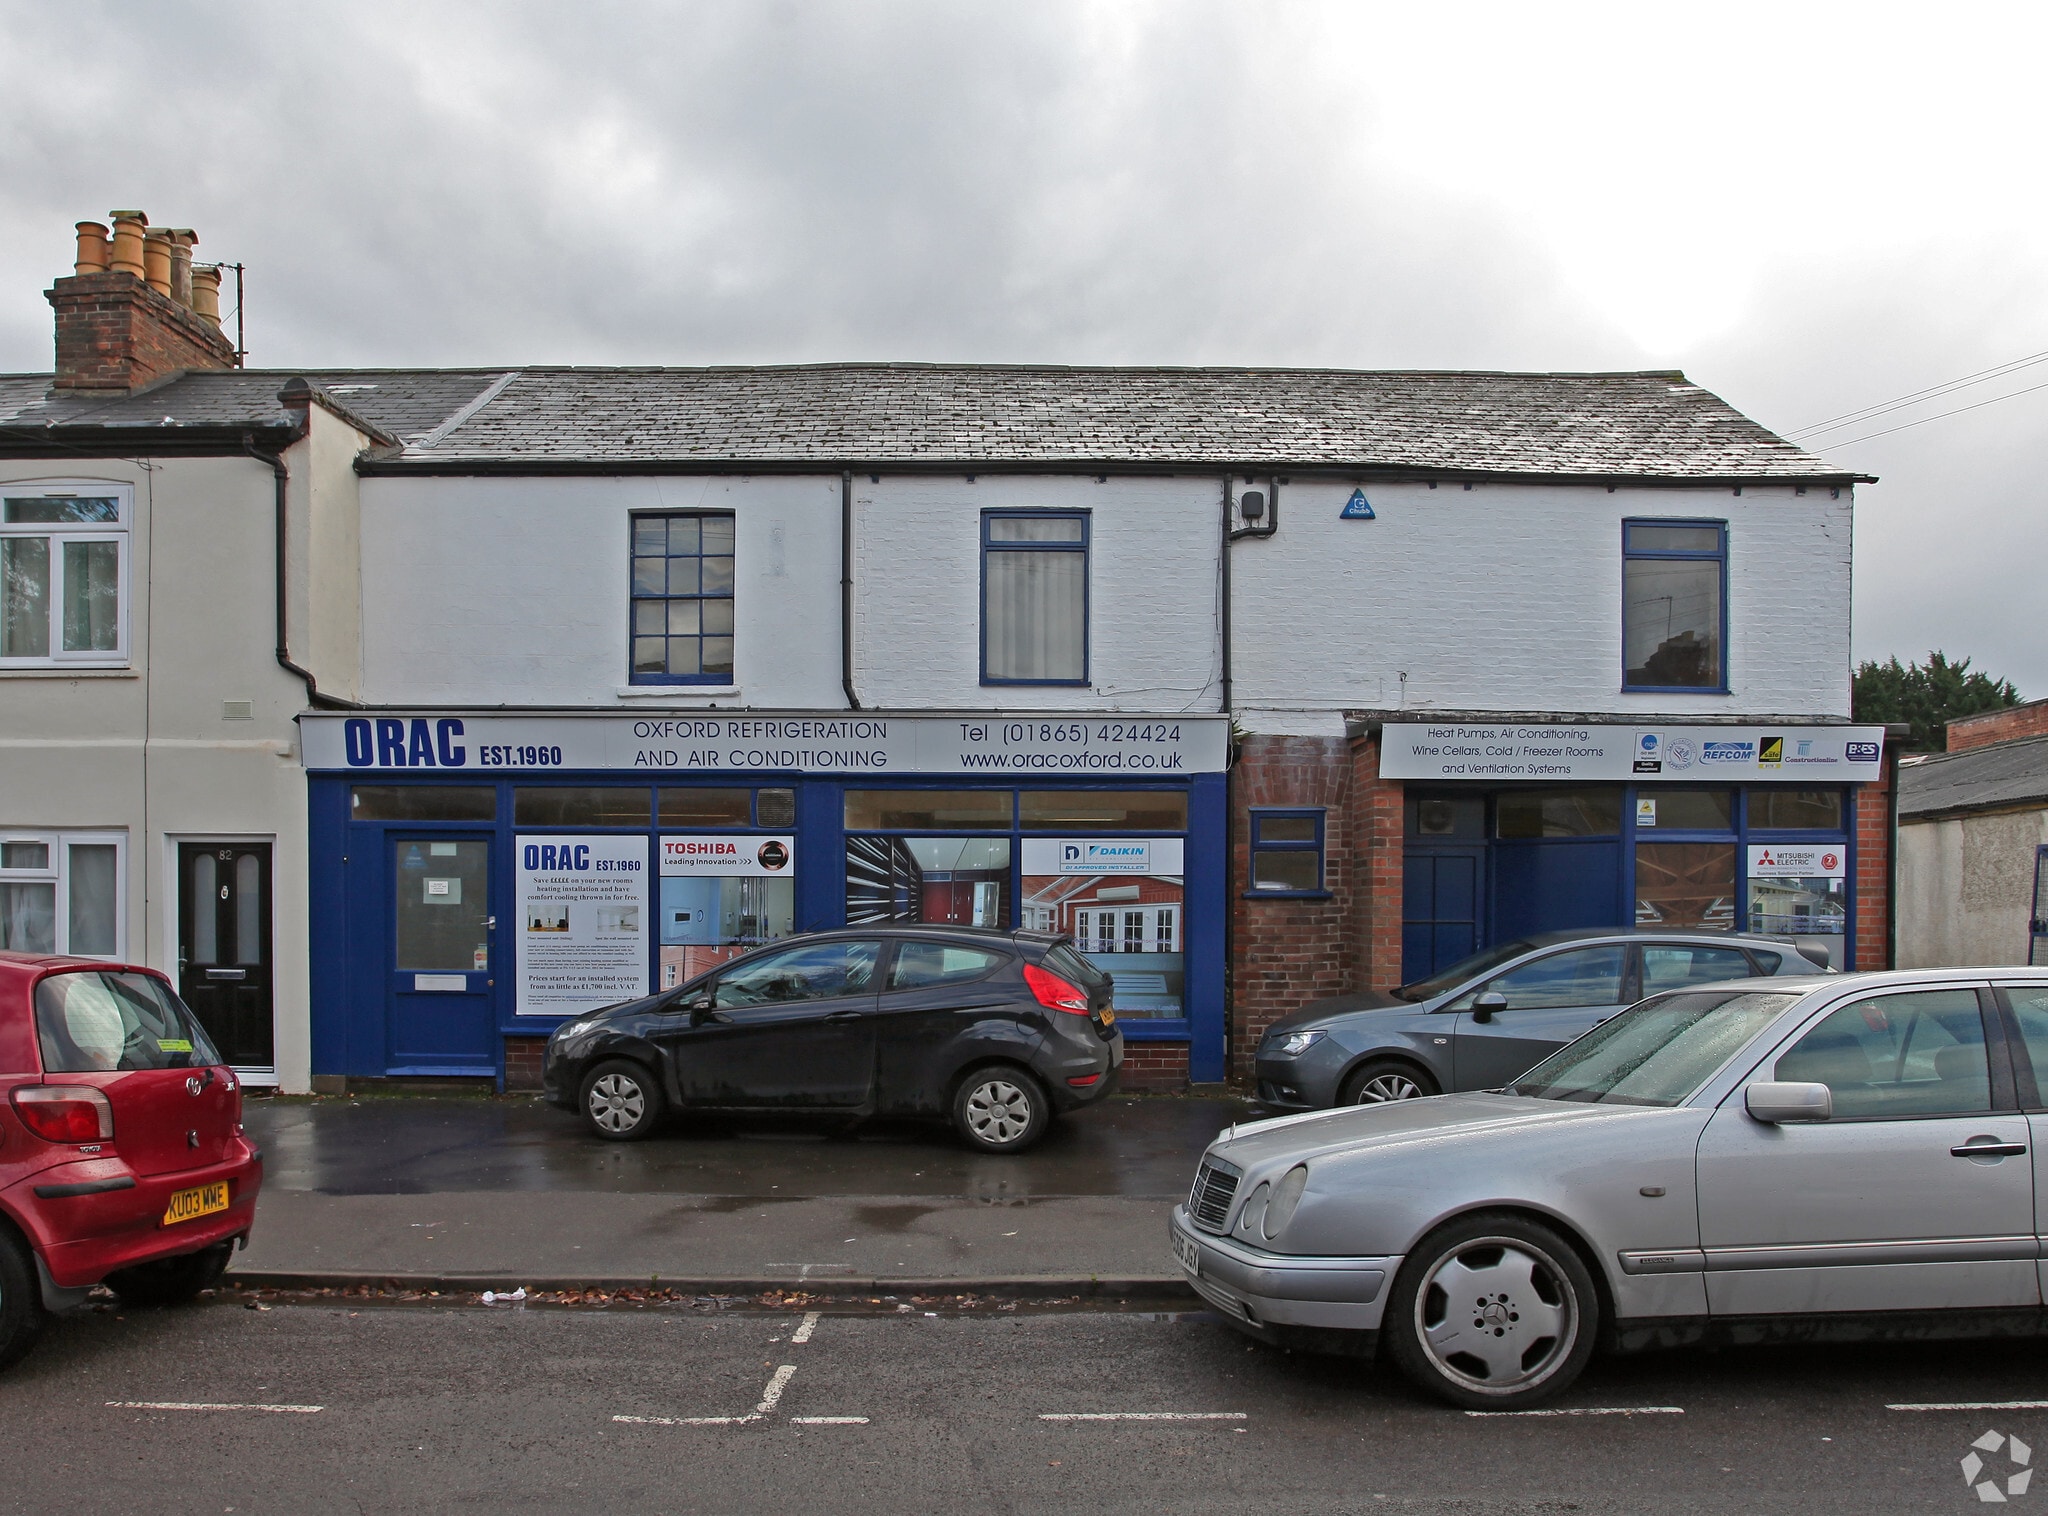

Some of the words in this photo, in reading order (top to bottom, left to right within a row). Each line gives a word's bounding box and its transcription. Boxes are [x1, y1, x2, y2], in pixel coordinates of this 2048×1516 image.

[633, 721, 721, 739] OXFORD
[727, 721, 887, 740] REFRIGERATION
[961, 723, 989, 742] Tel
[1003, 723, 1090, 746] (01865)
[1097, 724, 1181, 743] 424424
[1427, 728, 1455, 739] Heat
[1457, 728, 1497, 740] Pumps,
[1500, 728, 1515, 739] Air
[1517, 728, 1591, 741] Conditioning,
[345, 718, 465, 767] ORAC
[480, 745, 562, 766] EST.1960
[1412, 745, 1439, 756] Wine
[1442, 745, 1482, 757] Cellars,
[1485, 746, 1513, 757] Cold
[1523, 746, 1563, 757] Freezer
[1565, 747, 1604, 757] Rooms
[1703, 750, 1751, 760] REFCOM
[1848, 744, 1876, 755] B&ES
[634, 749, 678, 767] AND
[687, 749, 720, 767] AIR
[728, 750, 887, 768] CONDITIONING
[961, 751, 1183, 770] www.oracoxford.co.uk
[1441, 763, 1465, 774] and
[1467, 763, 1525, 774] Ventilation
[1527, 764, 1571, 776] Systems
[219, 849, 232, 860] 82
[665, 843, 737, 854] TOSHIBA
[1100, 847, 1145, 856] DAIKIN
[524, 844, 590, 871] ORAC
[596, 860, 641, 871] EST.1960
[664, 858, 695, 867] Leading
[554, 894, 578, 902] cooling
[169, 1192, 200, 1220] KU03
